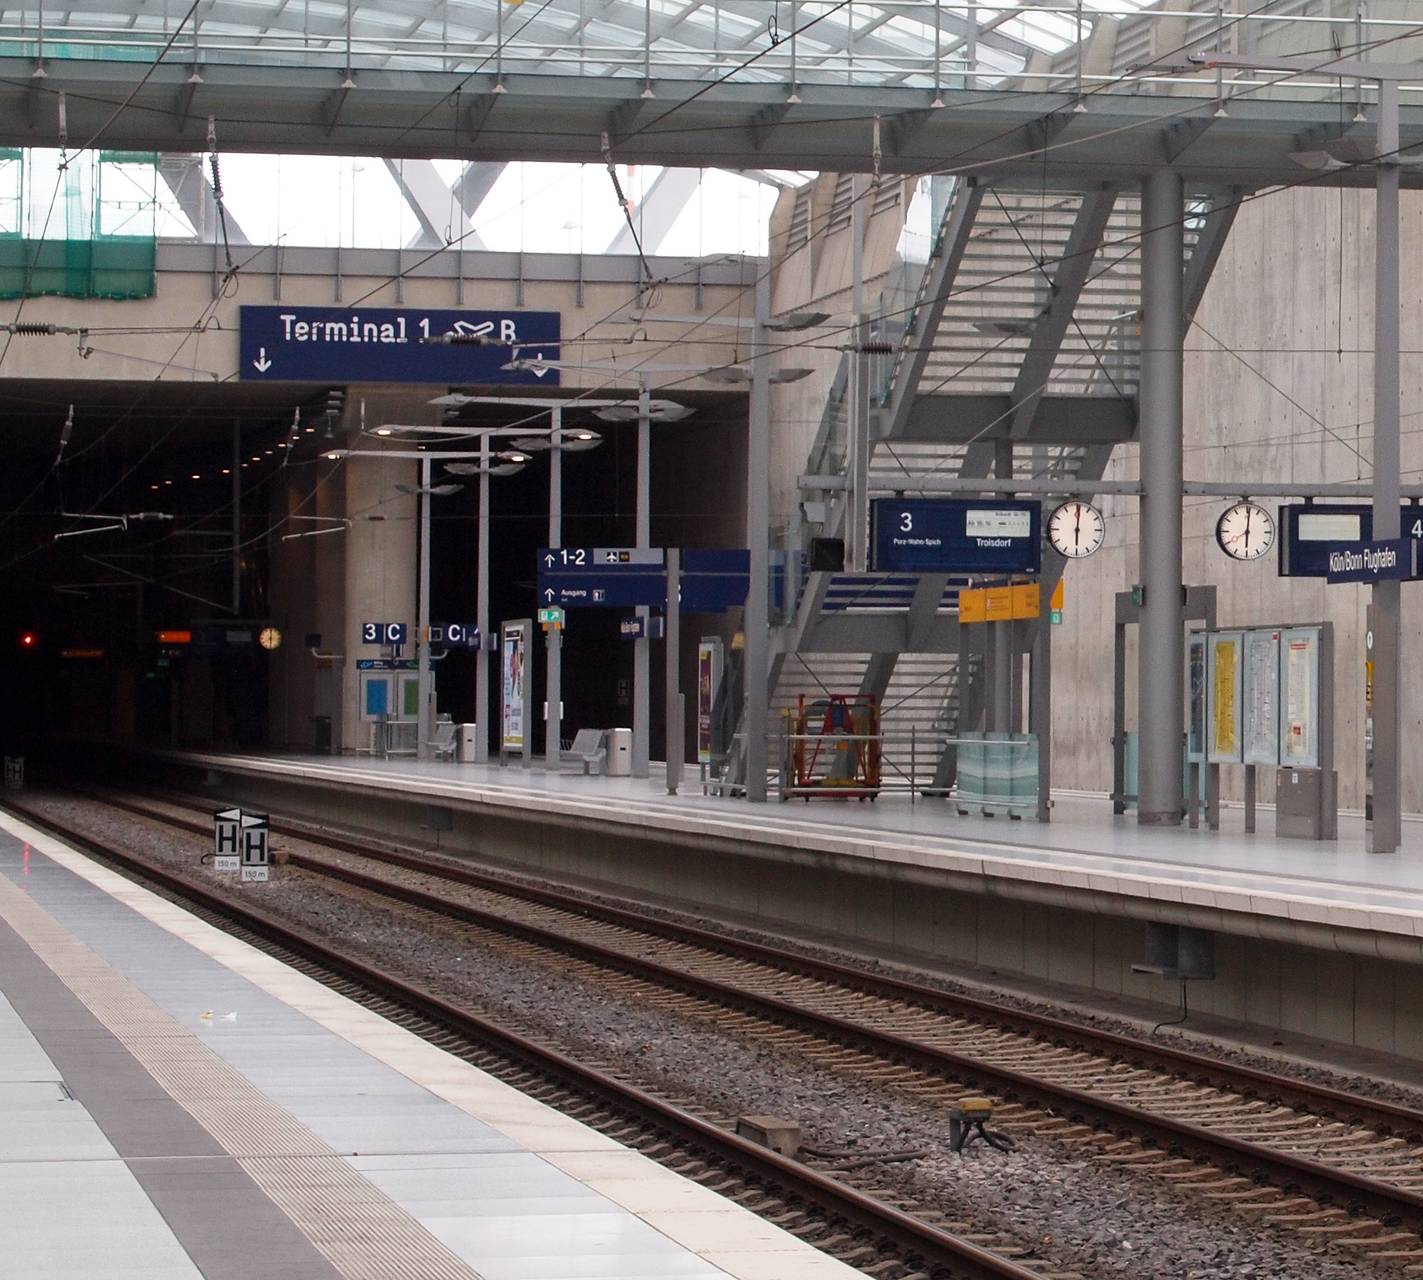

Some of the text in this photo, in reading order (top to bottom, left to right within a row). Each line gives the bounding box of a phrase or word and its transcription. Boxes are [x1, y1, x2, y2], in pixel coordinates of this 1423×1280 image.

[280, 314, 407, 343] Terminal
[501, 320, 516, 345] B
[900, 512, 913, 531] 3
[1411, 519, 1423, 538] 4
[976, 538, 1012, 547] Troisdorf
[560, 549, 586, 565] 1-2
[1329, 546, 1397, 573] Köln/Bonn Flughafen
[561, 589, 587, 598] Ausgang
[365, 624, 400, 640] 3 C
[449, 624, 461, 641] C
[218, 824, 237, 852] H
[246, 832, 265, 861] H
